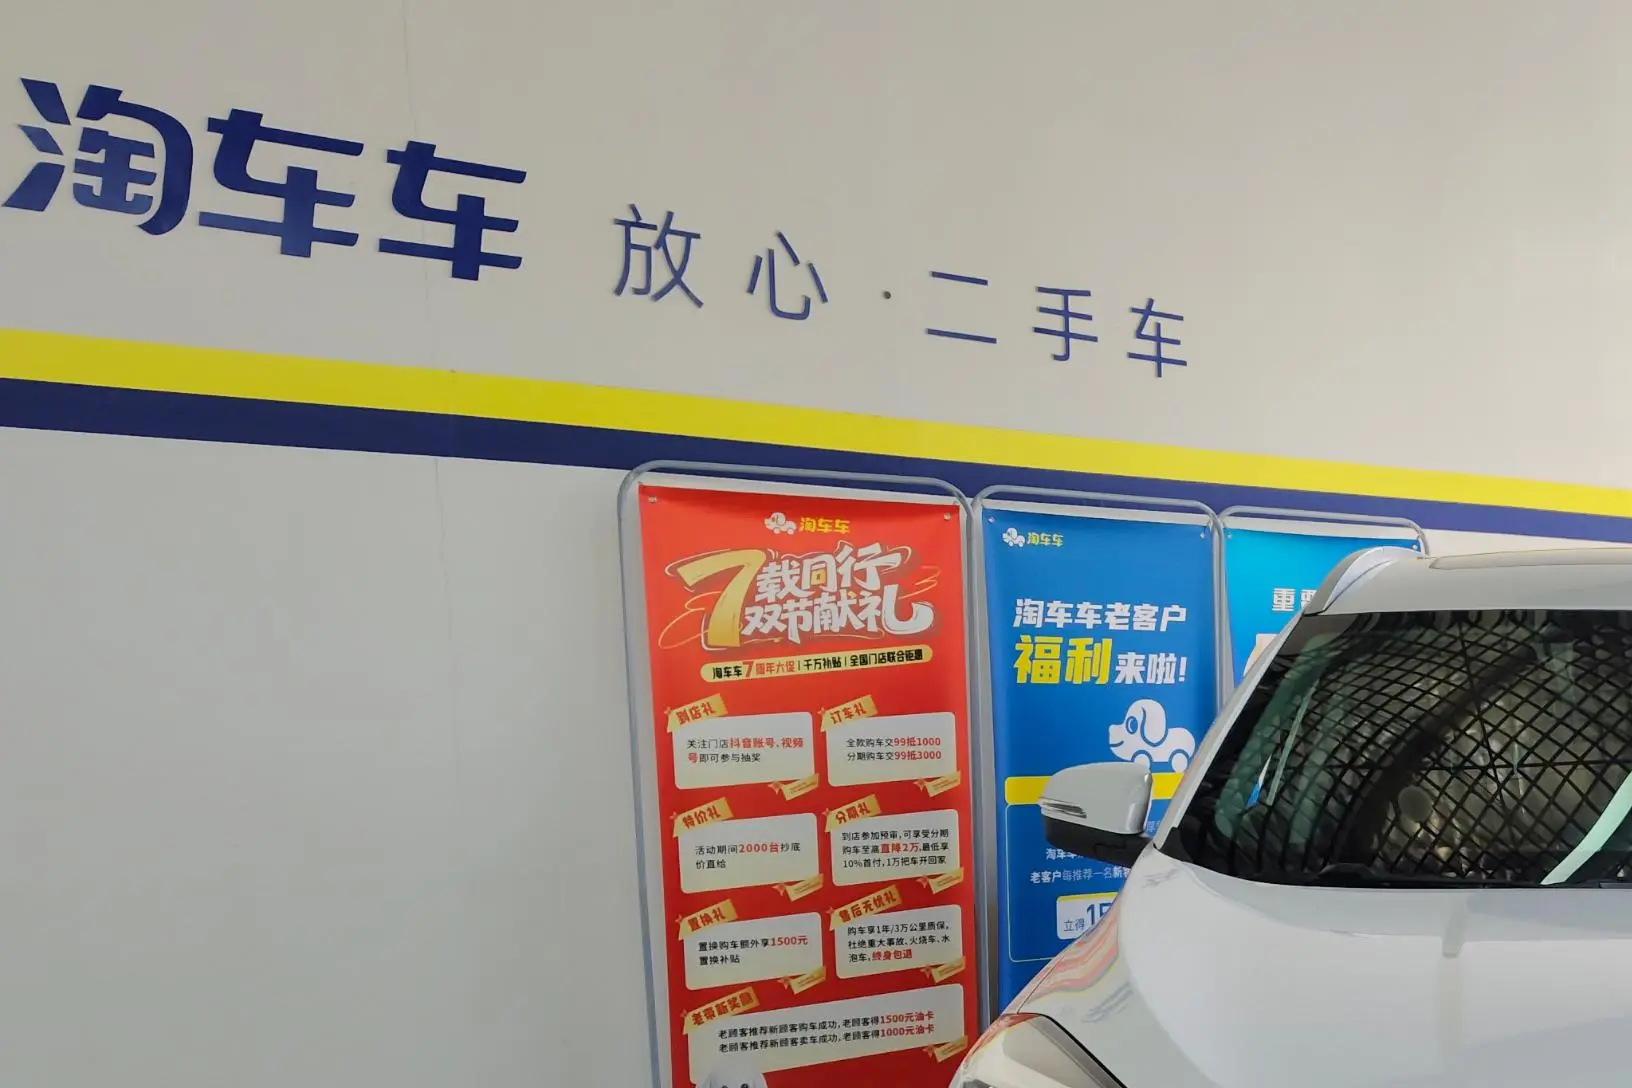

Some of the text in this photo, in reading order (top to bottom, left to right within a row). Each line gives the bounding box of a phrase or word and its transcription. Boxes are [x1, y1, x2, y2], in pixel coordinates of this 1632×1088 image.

[2, 78, 527, 281] 淘车车
[799, 517, 850, 534] 淘车车
[1027, 532, 1064, 547] 淘车车
[741, 584, 934, 643] 双节献礼
[1013, 598, 1187, 632] 淘车车老客户
[676, 702, 716, 725] 到店礼
[830, 702, 867, 724] 订车礼
[682, 805, 720, 829] 特价礼
[835, 802, 871, 824] 分期礼
[696, 859, 726, 869] 价直给
[688, 907, 726, 932] 置换礼
[699, 955, 740, 966] 置换补贴
